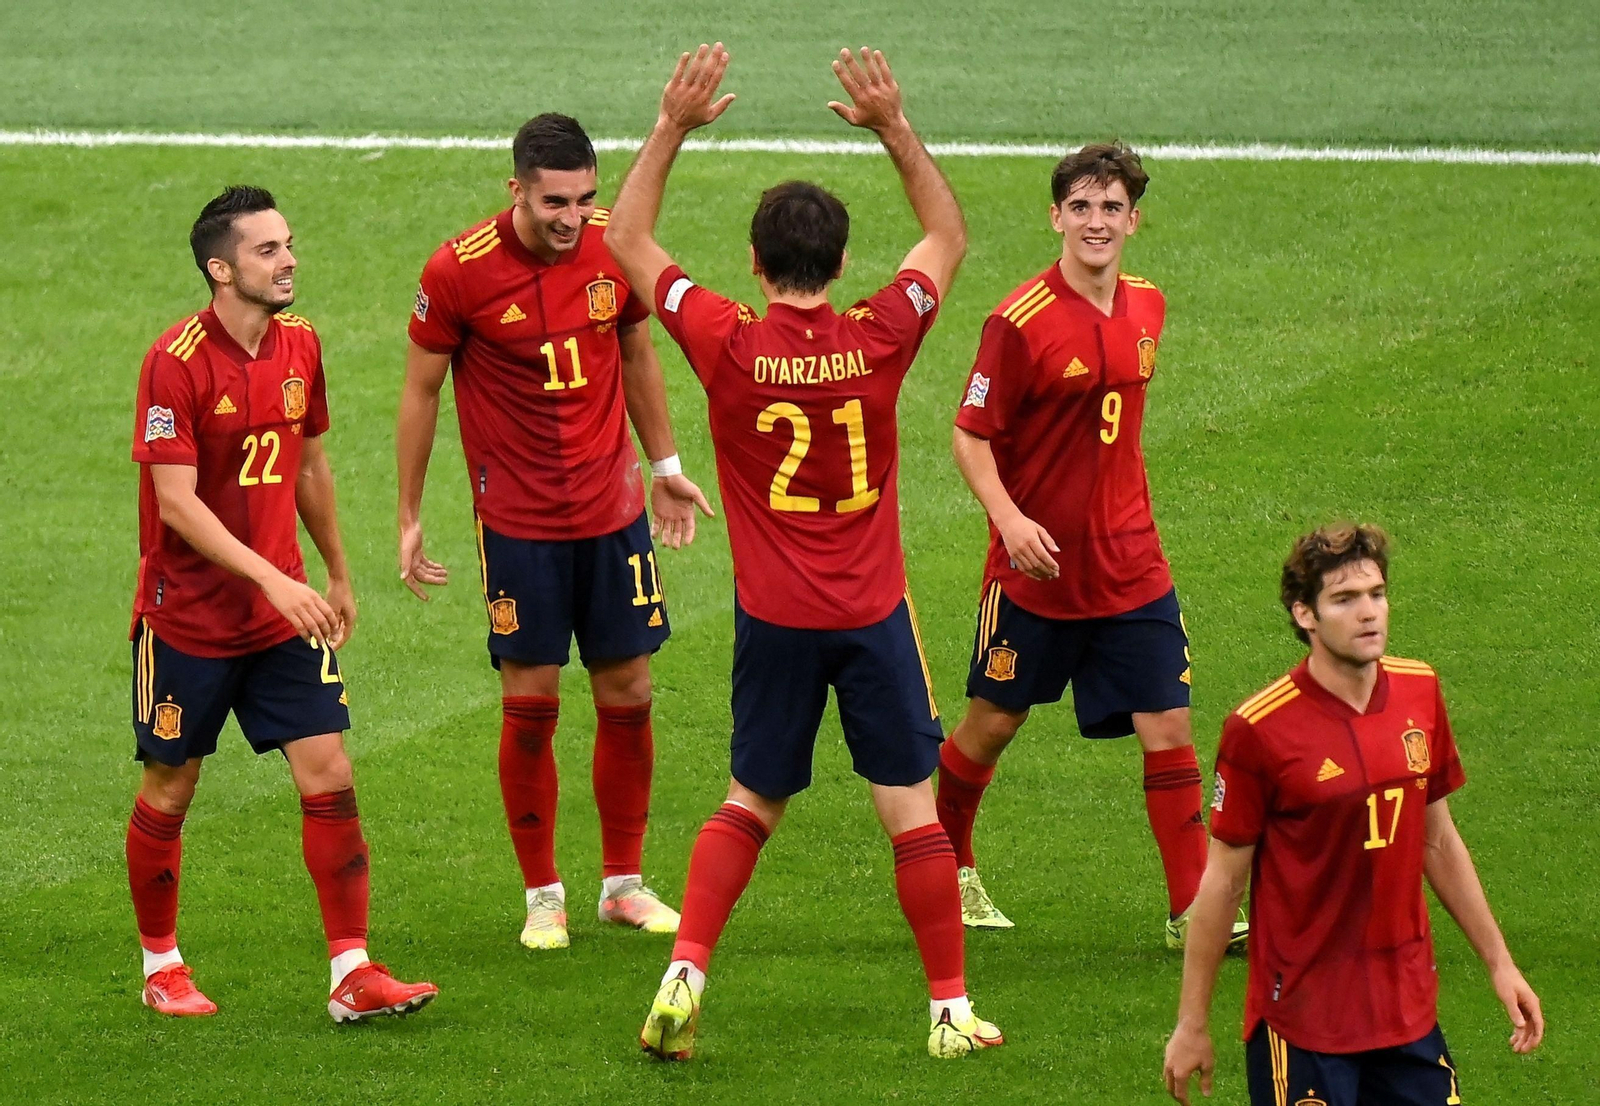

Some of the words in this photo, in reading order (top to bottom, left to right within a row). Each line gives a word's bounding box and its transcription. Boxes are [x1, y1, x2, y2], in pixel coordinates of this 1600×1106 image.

[540, 336, 588, 391] 11
[754, 349, 873, 385] OYARZABAL
[1100, 391, 1123, 445] 9
[238, 430, 283, 487] 22
[756, 398, 880, 513] 21
[627, 550, 662, 606] 11
[1363, 787, 1404, 850] 17
